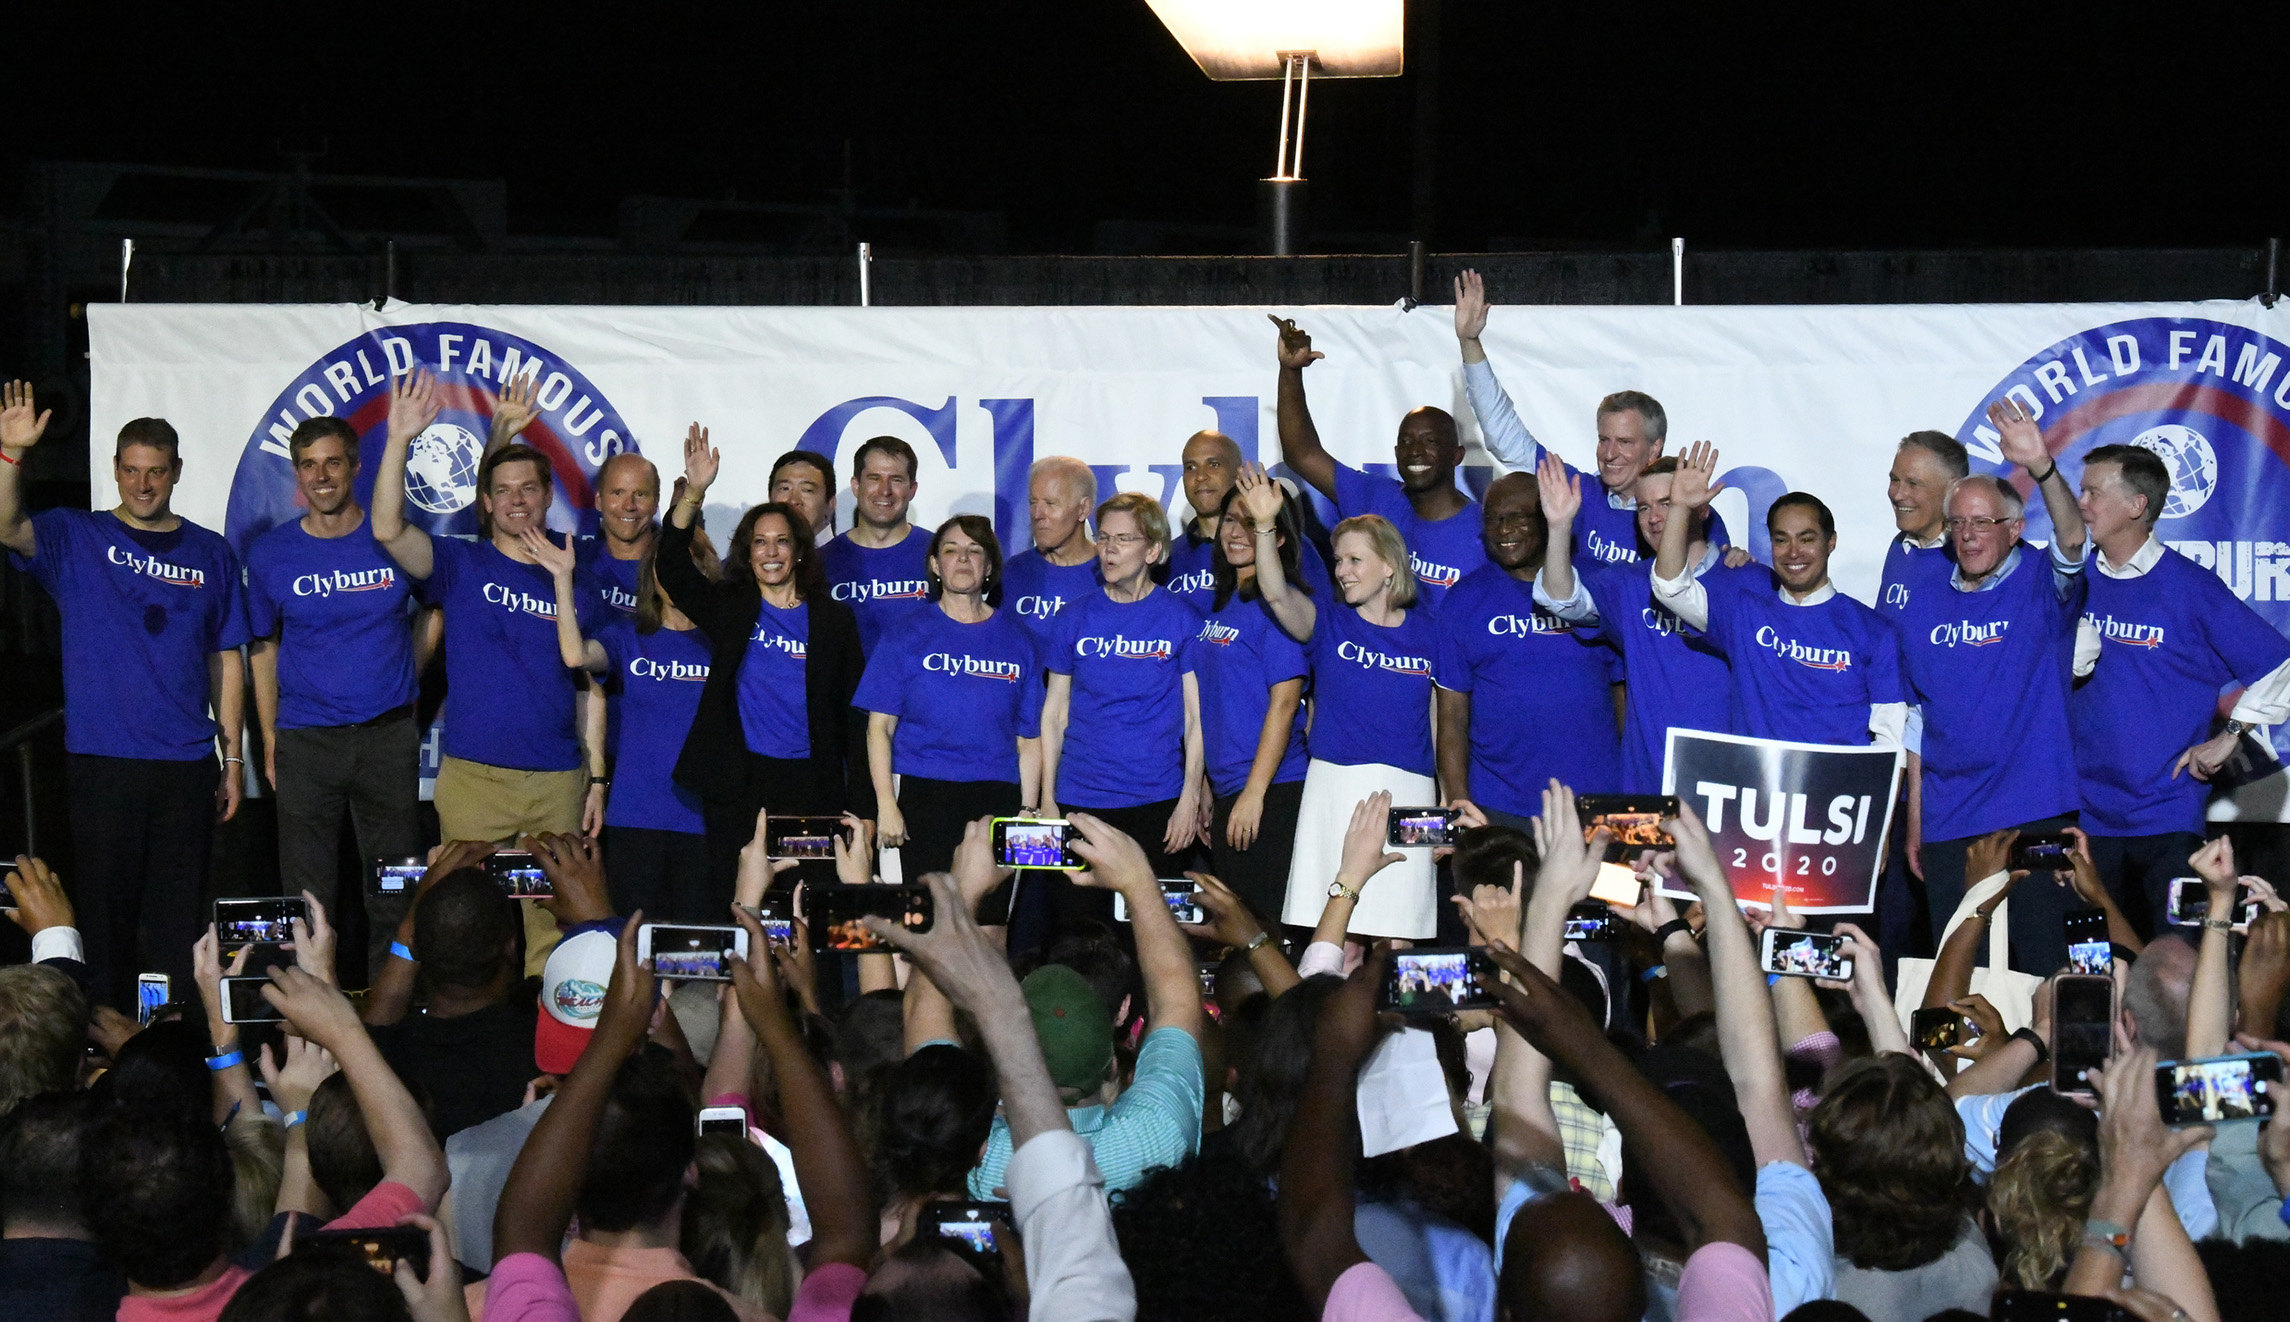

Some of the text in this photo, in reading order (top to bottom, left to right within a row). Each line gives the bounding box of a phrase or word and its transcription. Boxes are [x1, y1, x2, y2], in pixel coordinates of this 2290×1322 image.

[259, 334, 624, 467] WORLD FAMOUS
[1965, 334, 2141, 466] WORLD
[1587, 529, 1642, 563] Clybu
[107, 545, 205, 585] Clyburn
[293, 567, 395, 598] Clyburn
[831, 579, 930, 603] Clyburn
[1167, 569, 1216, 594] Clyb
[483, 582, 558, 614] Clybu
[1016, 596, 1067, 619] Clyb
[1488, 613, 1571, 639] Clybu
[1642, 608, 1687, 637] Clyb
[1931, 620, 2009, 647] Clybur
[2085, 611, 2164, 643] lyburn
[1076, 634, 1172, 657] Clyburn
[1337, 640, 1431, 673] Clyburn
[1755, 625, 1851, 667] Clyburn
[630, 657, 711, 682] Clybur
[922, 653, 1020, 678] Clyburn
[1696, 781, 1872, 845] TULSI
[1732, 848, 1837, 876] 2020
